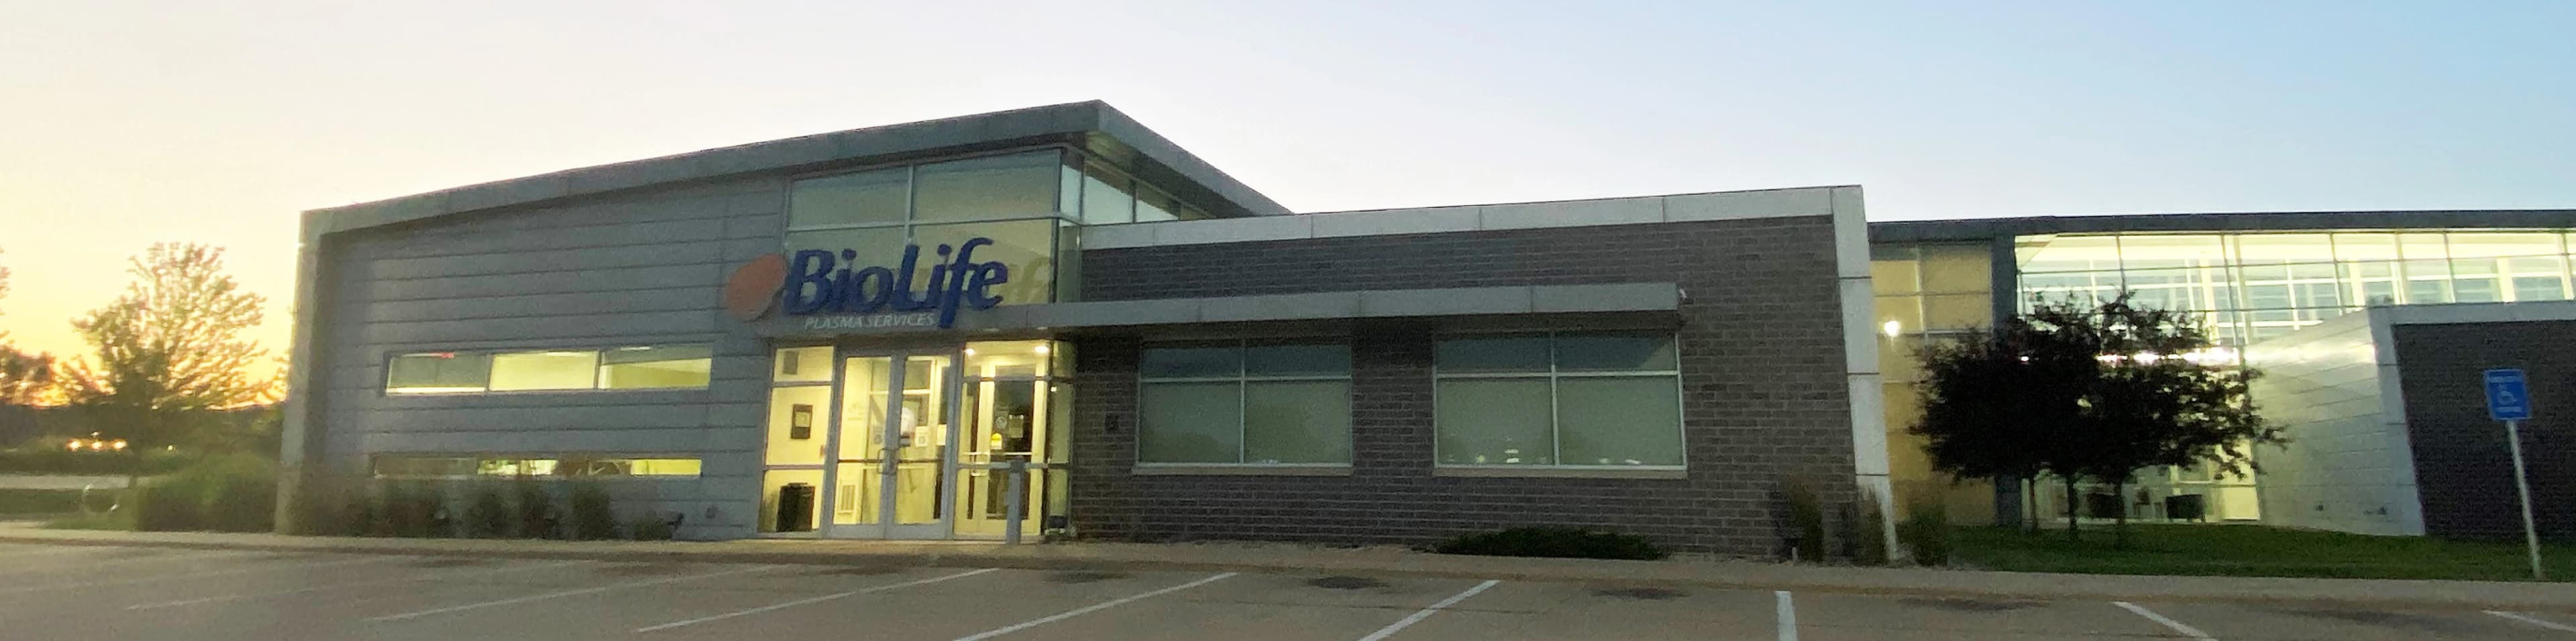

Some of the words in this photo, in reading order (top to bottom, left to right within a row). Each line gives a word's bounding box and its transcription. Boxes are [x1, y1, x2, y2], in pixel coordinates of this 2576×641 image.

[784, 237, 1008, 329] BioLife
[805, 315, 862, 330] PLASMA
[863, 312, 935, 328] SERVICES
